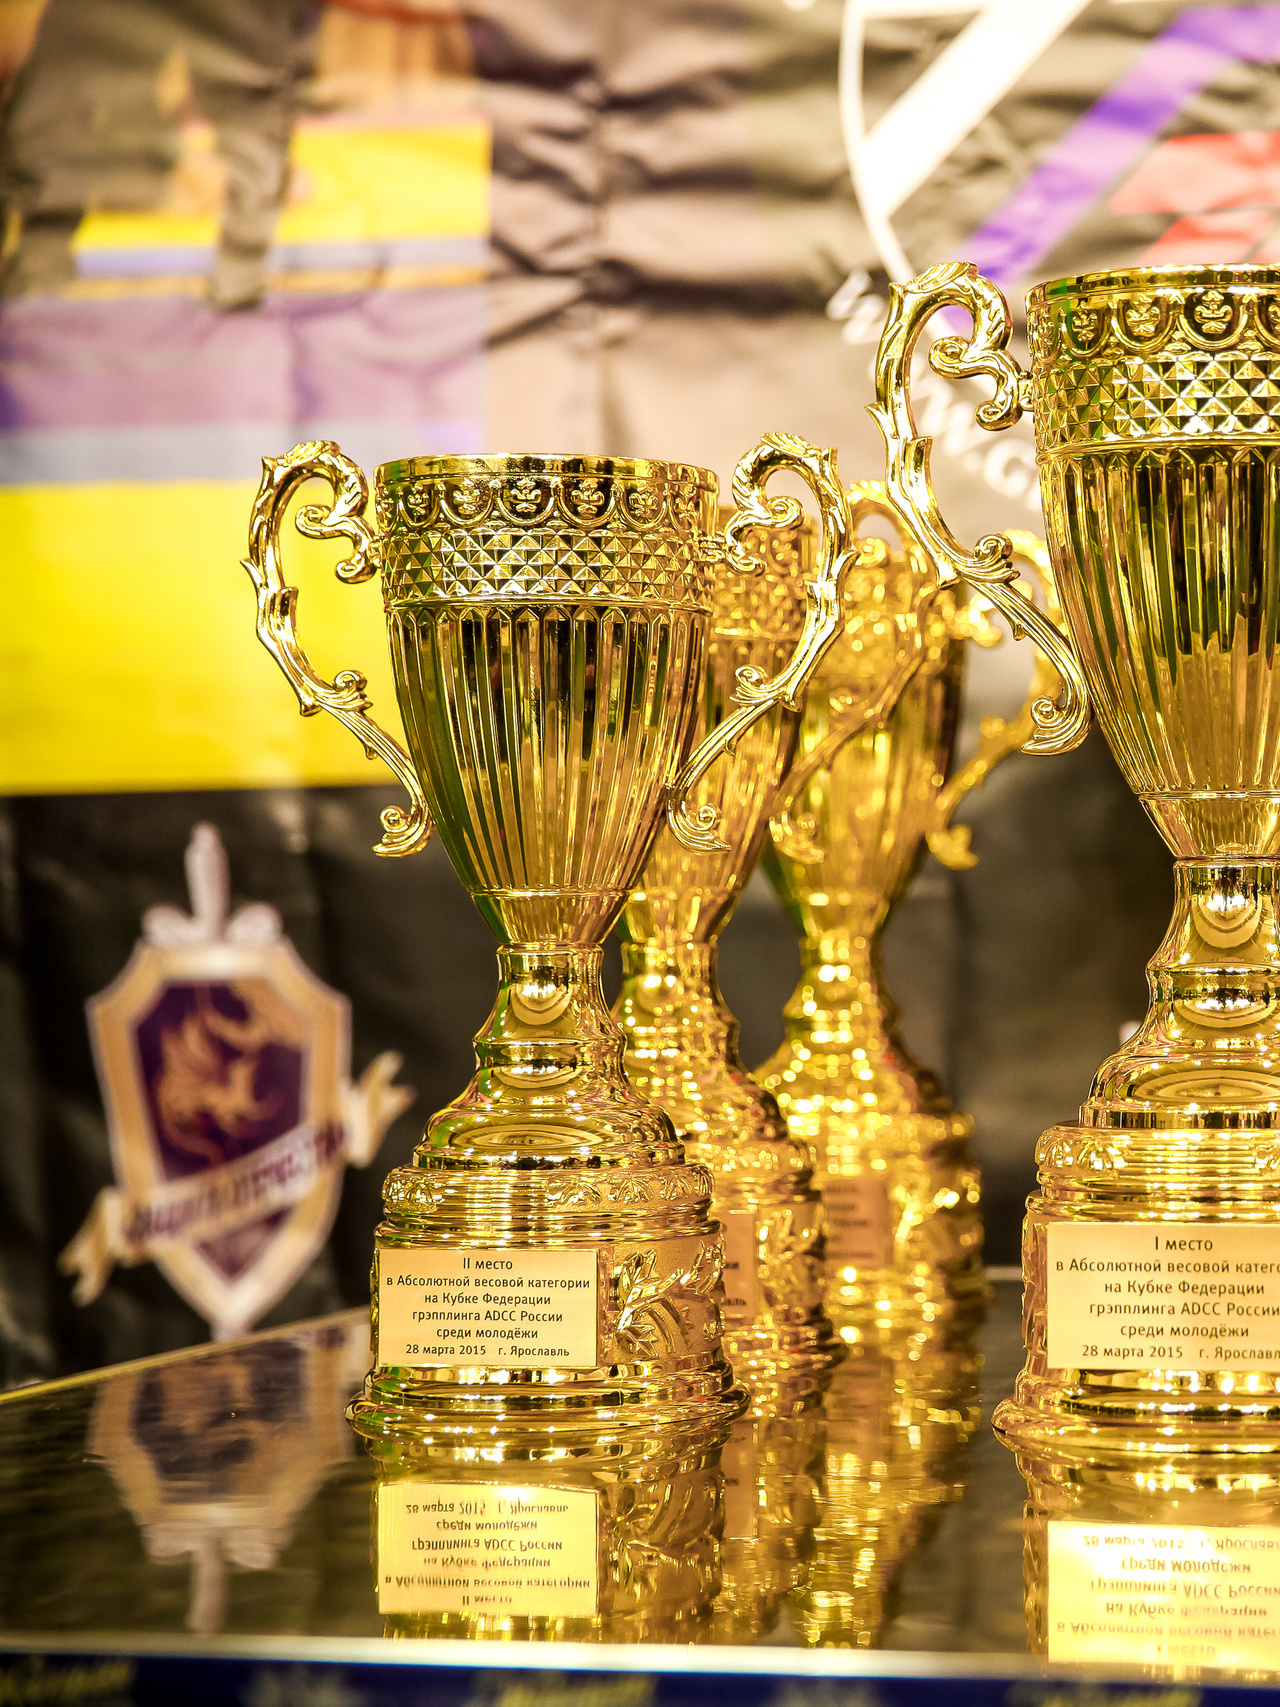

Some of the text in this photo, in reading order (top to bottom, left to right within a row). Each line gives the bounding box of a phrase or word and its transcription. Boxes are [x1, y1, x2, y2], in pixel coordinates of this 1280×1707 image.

[1165, 1239, 1213, 1251] место
[463, 1257, 513, 1270] II место
[1056, 1261, 1064, 1271] в
[1069, 1258, 1161, 1273] Абсолютной
[1167, 1260, 1229, 1273] весовой
[386, 1275, 590, 1290] в Абсолютной весовой категории
[1104, 1280, 1265, 1296] на Кубке Федерации
[424, 1292, 551, 1307] на Кубке Федерации
[412, 1310, 563, 1322] грэпплинга ADCC России
[1089, 1302, 1280, 1317] грэпплинга ADCC России
[436, 1328, 538, 1340] среди молодёжи
[1120, 1324, 1249, 1338] среди молодёжи
[406, 1344, 570, 1358] 28 марта 2015 г. Ярославль
[1082, 1345, 1098, 1357] 28
[1103, 1347, 1144, 1360] марта
[1149, 1346, 1183, 1358] 2015
[1199, 1348, 1209, 1359] г.
